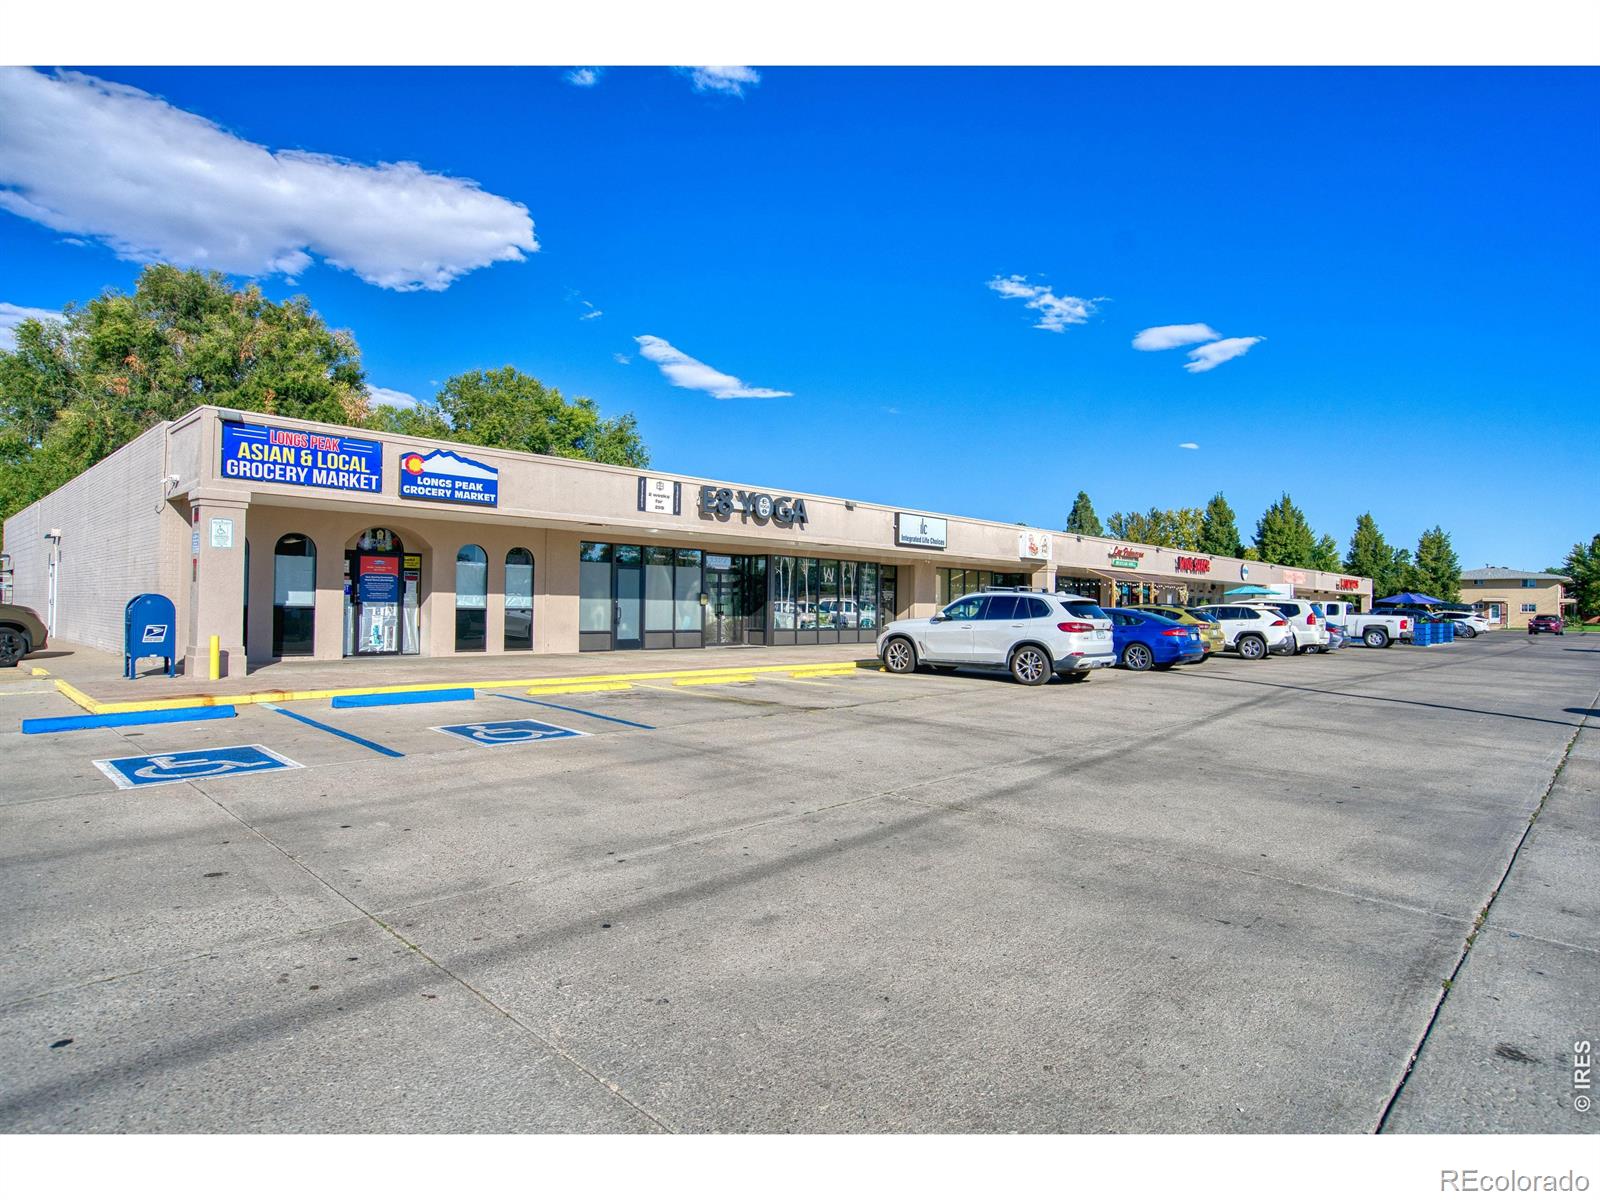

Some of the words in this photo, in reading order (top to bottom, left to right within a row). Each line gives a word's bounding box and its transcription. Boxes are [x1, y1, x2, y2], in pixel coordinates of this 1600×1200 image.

[270, 429, 308, 448] LONGS
[310, 436, 340, 452] PEAK
[238, 442, 294, 464] ASIAN
[301, 450, 312, 466] &
[317, 451, 370, 473] LOCAL
[226, 459, 307, 482] GROCERY
[313, 469, 379, 490] MARKET
[417, 476, 452, 488] LONGS
[455, 481, 484, 491] PEAK
[403, 485, 452, 498] GROCERY
[454, 491, 496, 502] MARKET
[700, 485, 734, 516] E8
[737, 490, 809, 524] YOGA
